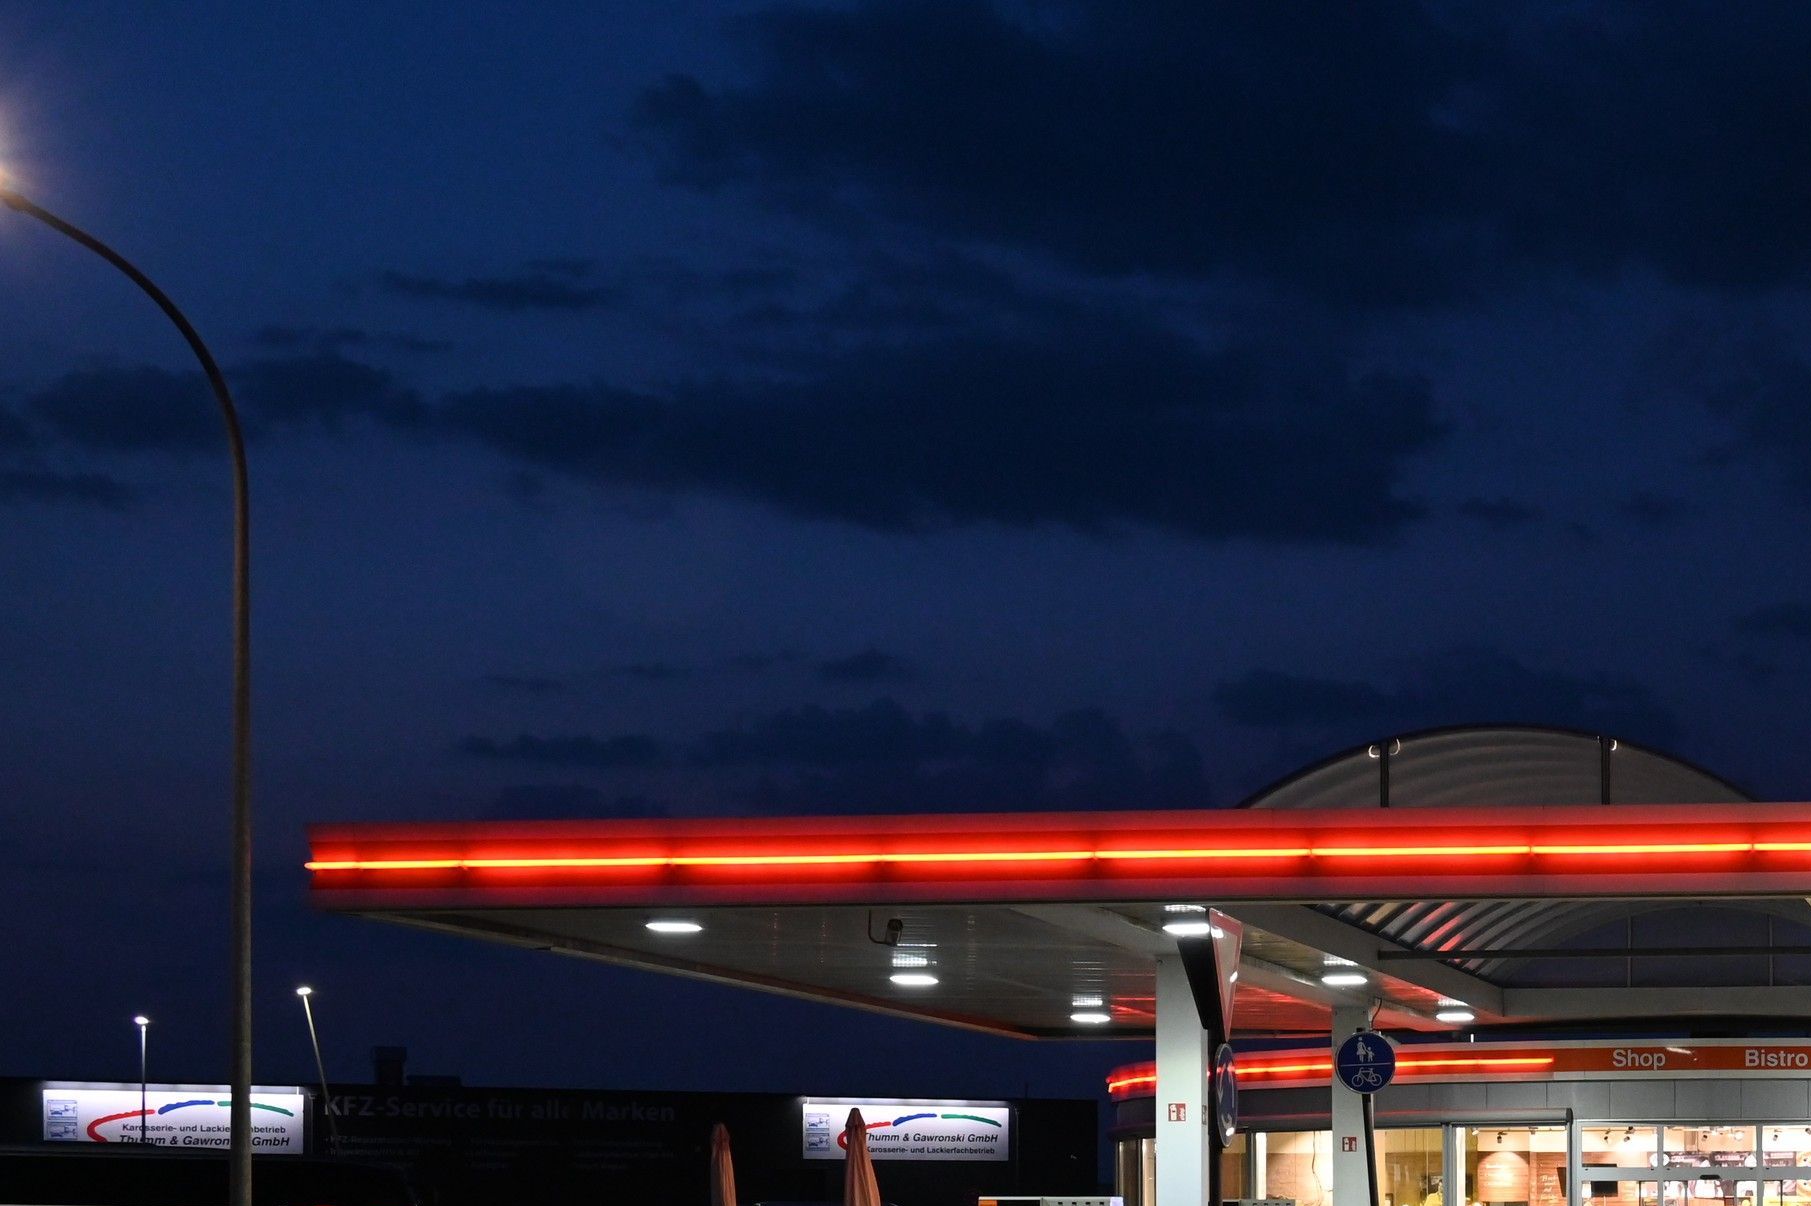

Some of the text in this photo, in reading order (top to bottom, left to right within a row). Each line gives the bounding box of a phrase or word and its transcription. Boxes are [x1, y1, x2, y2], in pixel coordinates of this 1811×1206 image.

[1612, 1048, 1666, 1071] Shop
[1745, 1048, 1808, 1068] Bistro
[324, 1096, 481, 1118] KFZ-Service
[582, 1101, 675, 1121] Marken
[179, 1123, 198, 1133] und
[170, 1136, 179, 1145] &
[252, 1136, 290, 1147] GmbH
[903, 1133, 910, 1142] &
[913, 1132, 966, 1143] Gawronski
[968, 1133, 999, 1143] GmbH
[926, 1147, 995, 1155] Lackierfachbetrieb
